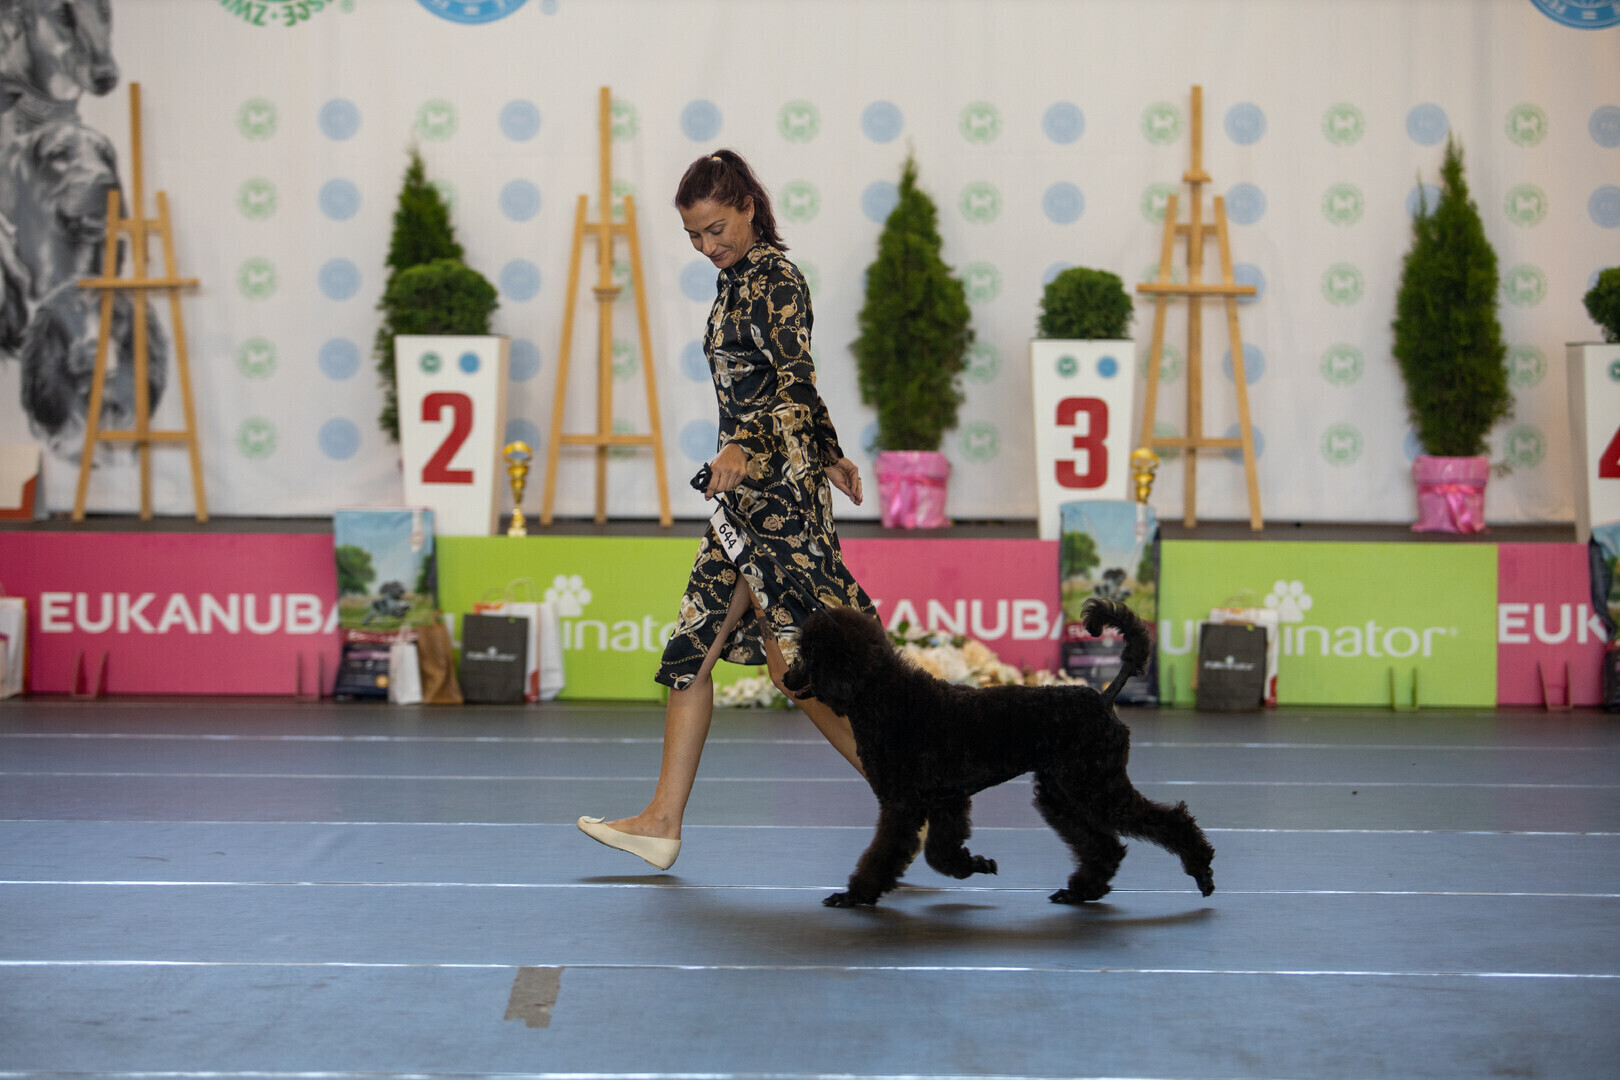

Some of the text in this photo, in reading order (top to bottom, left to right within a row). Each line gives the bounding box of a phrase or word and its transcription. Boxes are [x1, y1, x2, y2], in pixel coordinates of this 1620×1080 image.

[422, 392, 473, 484] 2
[1055, 397, 1108, 489] 3
[718, 523, 738, 550] 644
[871, 599, 1064, 641] ANUB
